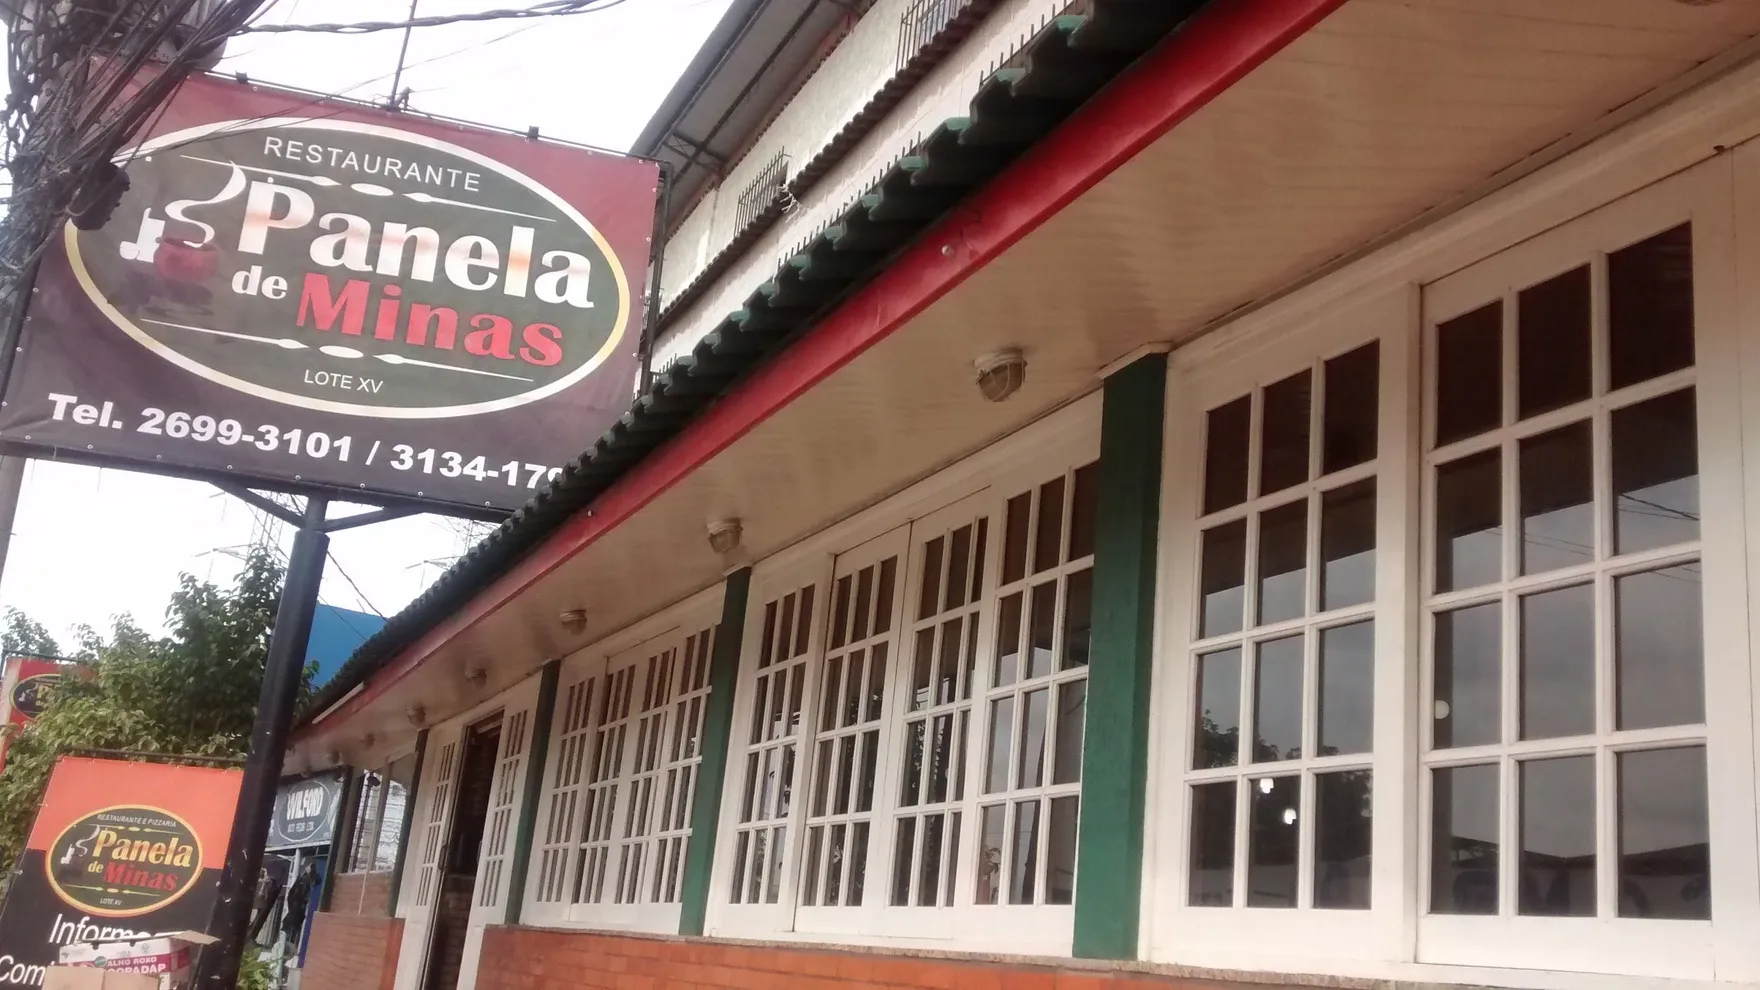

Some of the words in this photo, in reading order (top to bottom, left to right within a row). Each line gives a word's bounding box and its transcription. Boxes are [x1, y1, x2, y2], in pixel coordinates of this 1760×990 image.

[263, 136, 481, 193] RESTAURANTE
[237, 180, 595, 309] Panela
[231, 265, 288, 300] de
[296, 272, 564, 367] Minas
[304, 369, 353, 390] LOTE
[356, 376, 383, 394] XV
[48, 392, 123, 430] Tel.
[136, 407, 352, 462] 2699-3101
[97, 813, 142, 824] RESTAURANTE
[147, 818, 177, 828] PIZZARIA
[92, 829, 194, 867] Panela
[87, 860, 104, 873] de
[103, 861, 179, 891] Minas
[107, 958, 131, 967] ALHO
[133, 956, 157, 965] ROXO
